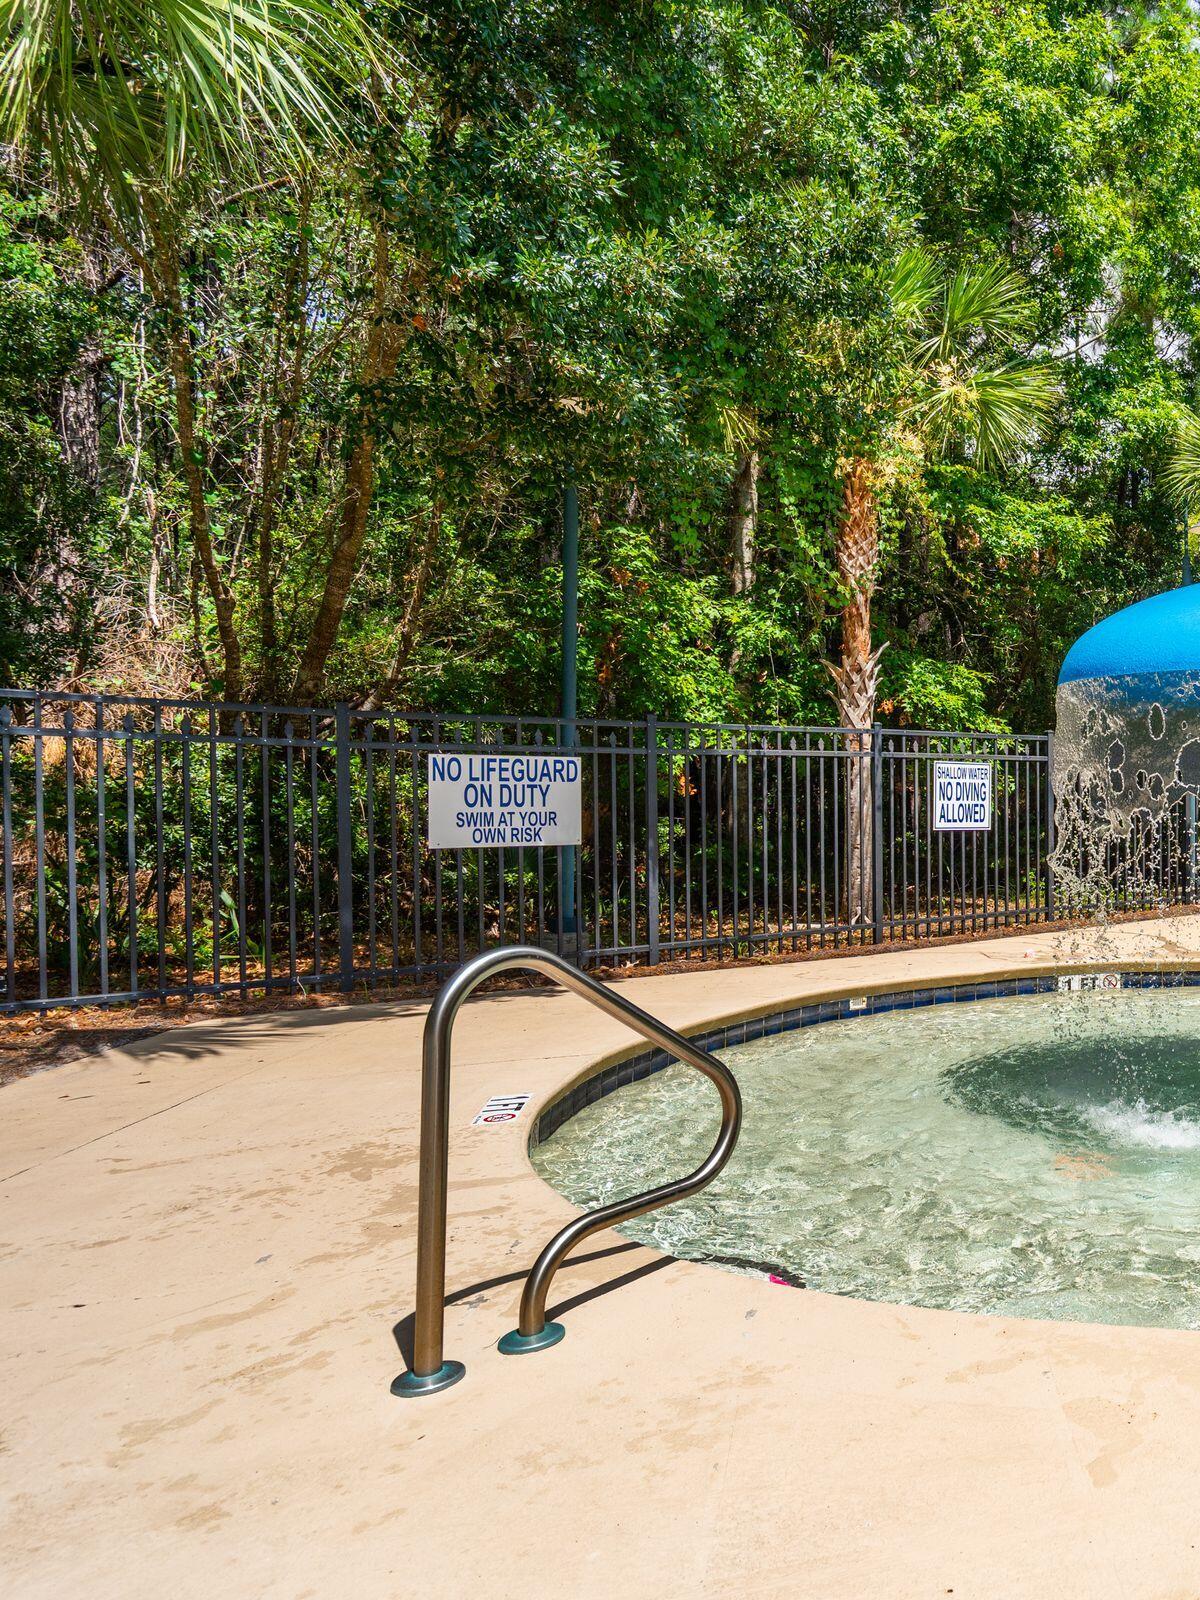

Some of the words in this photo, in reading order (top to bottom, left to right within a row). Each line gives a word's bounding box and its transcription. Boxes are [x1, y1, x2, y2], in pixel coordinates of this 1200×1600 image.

[432, 757, 462, 782] NO
[469, 757, 578, 783] LIFEGUARD
[937, 766, 967, 780] SHALLOW
[968, 768, 989, 780] WATER
[463, 783, 493, 808] ON
[499, 784, 551, 808] DUTY
[939, 781, 953, 801] NO
[956, 781, 987, 802] DIVING
[456, 811, 494, 828] SWIM
[498, 811, 515, 827] AT
[519, 811, 557, 827] YOUR
[939, 803, 986, 823] ALLOWED
[472, 827, 506, 844] OWN
[511, 827, 543, 843] RISK
[1064, 978, 1072, 991] 1
